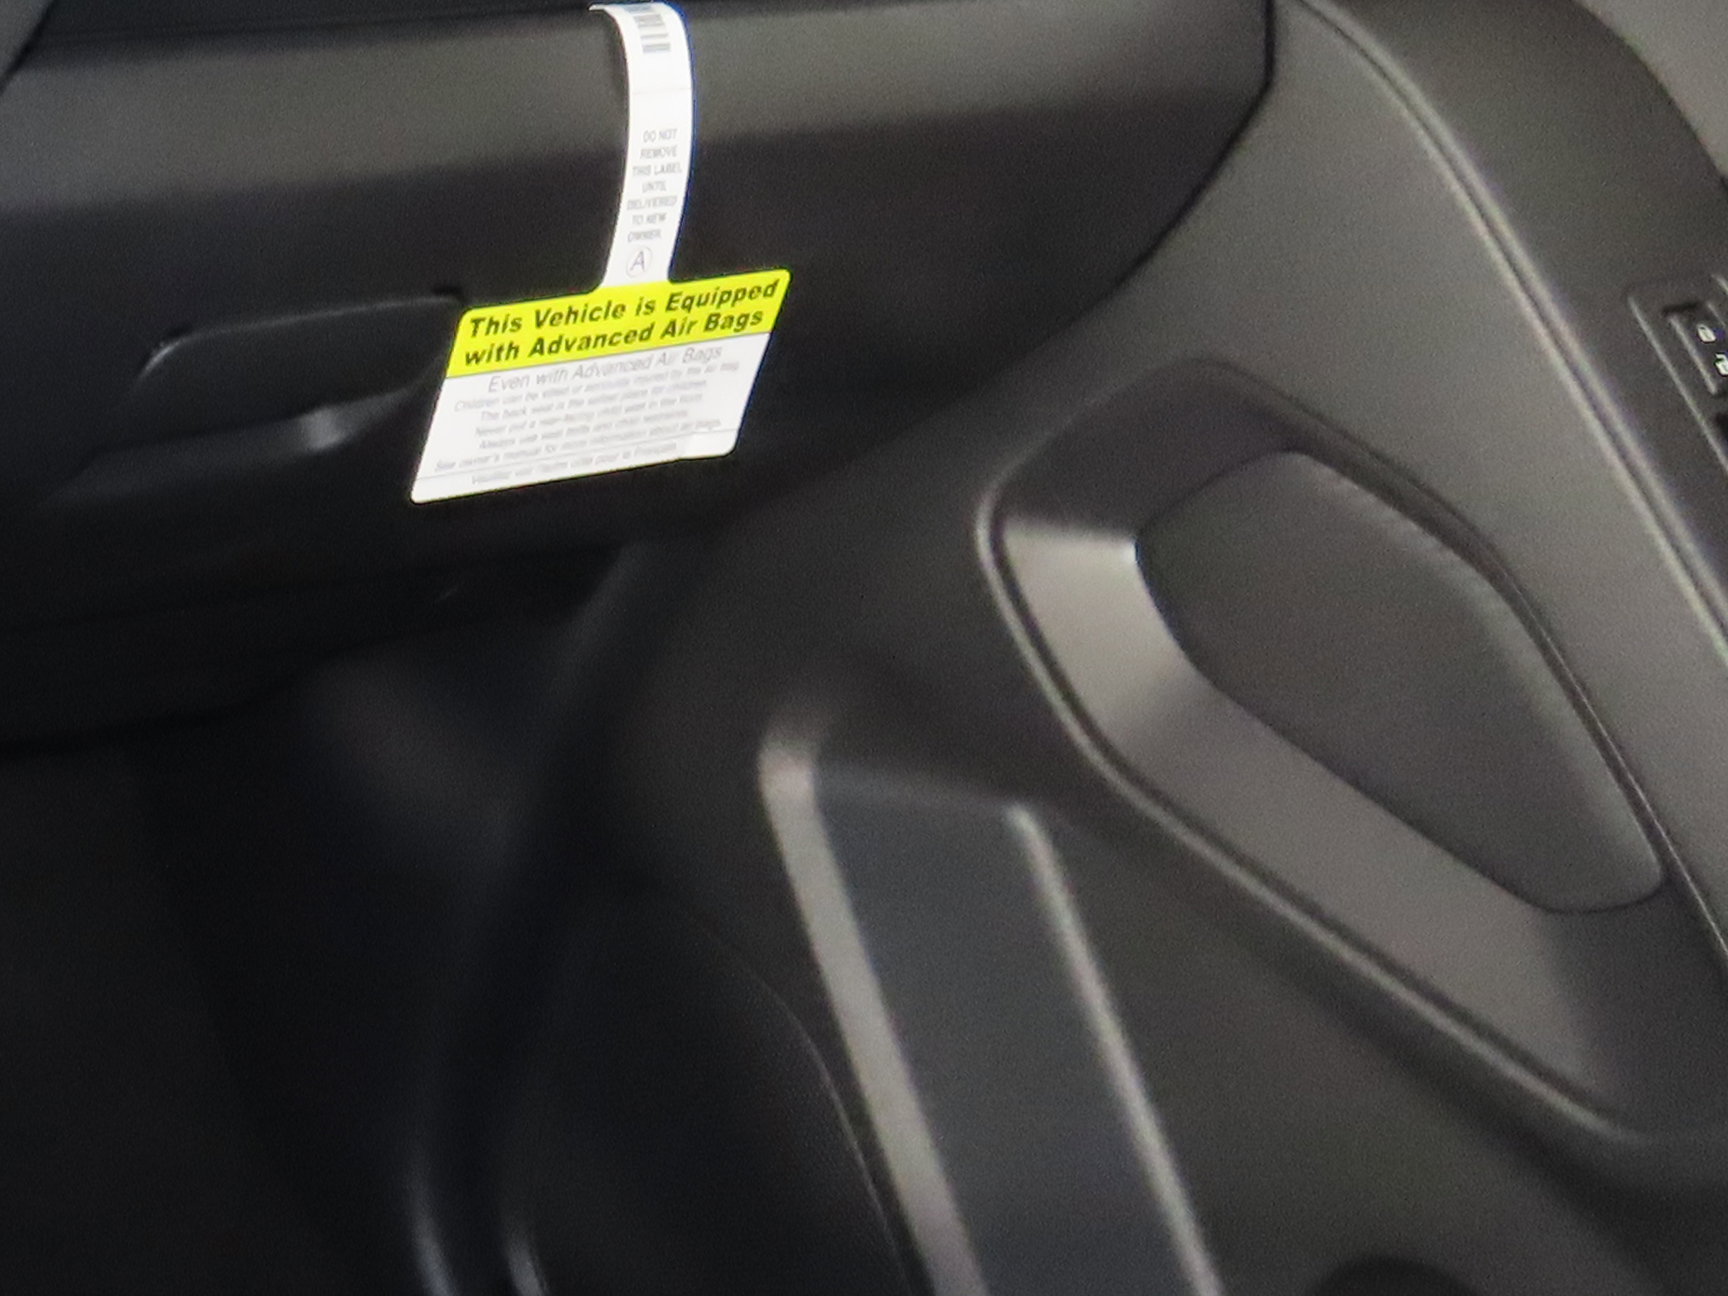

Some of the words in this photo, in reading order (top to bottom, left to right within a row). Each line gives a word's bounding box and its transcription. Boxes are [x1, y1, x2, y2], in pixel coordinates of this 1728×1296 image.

[465, 341, 520, 366] with
[528, 325, 654, 357] Advanced
[660, 316, 696, 339] Air
[703, 308, 764, 334] Bags
[470, 314, 523, 339] This
[534, 298, 625, 329] Vehicle
[636, 296, 656, 318] is
[665, 279, 780, 312] Equipped
[488, 373, 531, 393] Even
[535, 366, 569, 386] with
[572, 354, 652, 381] Advanced
